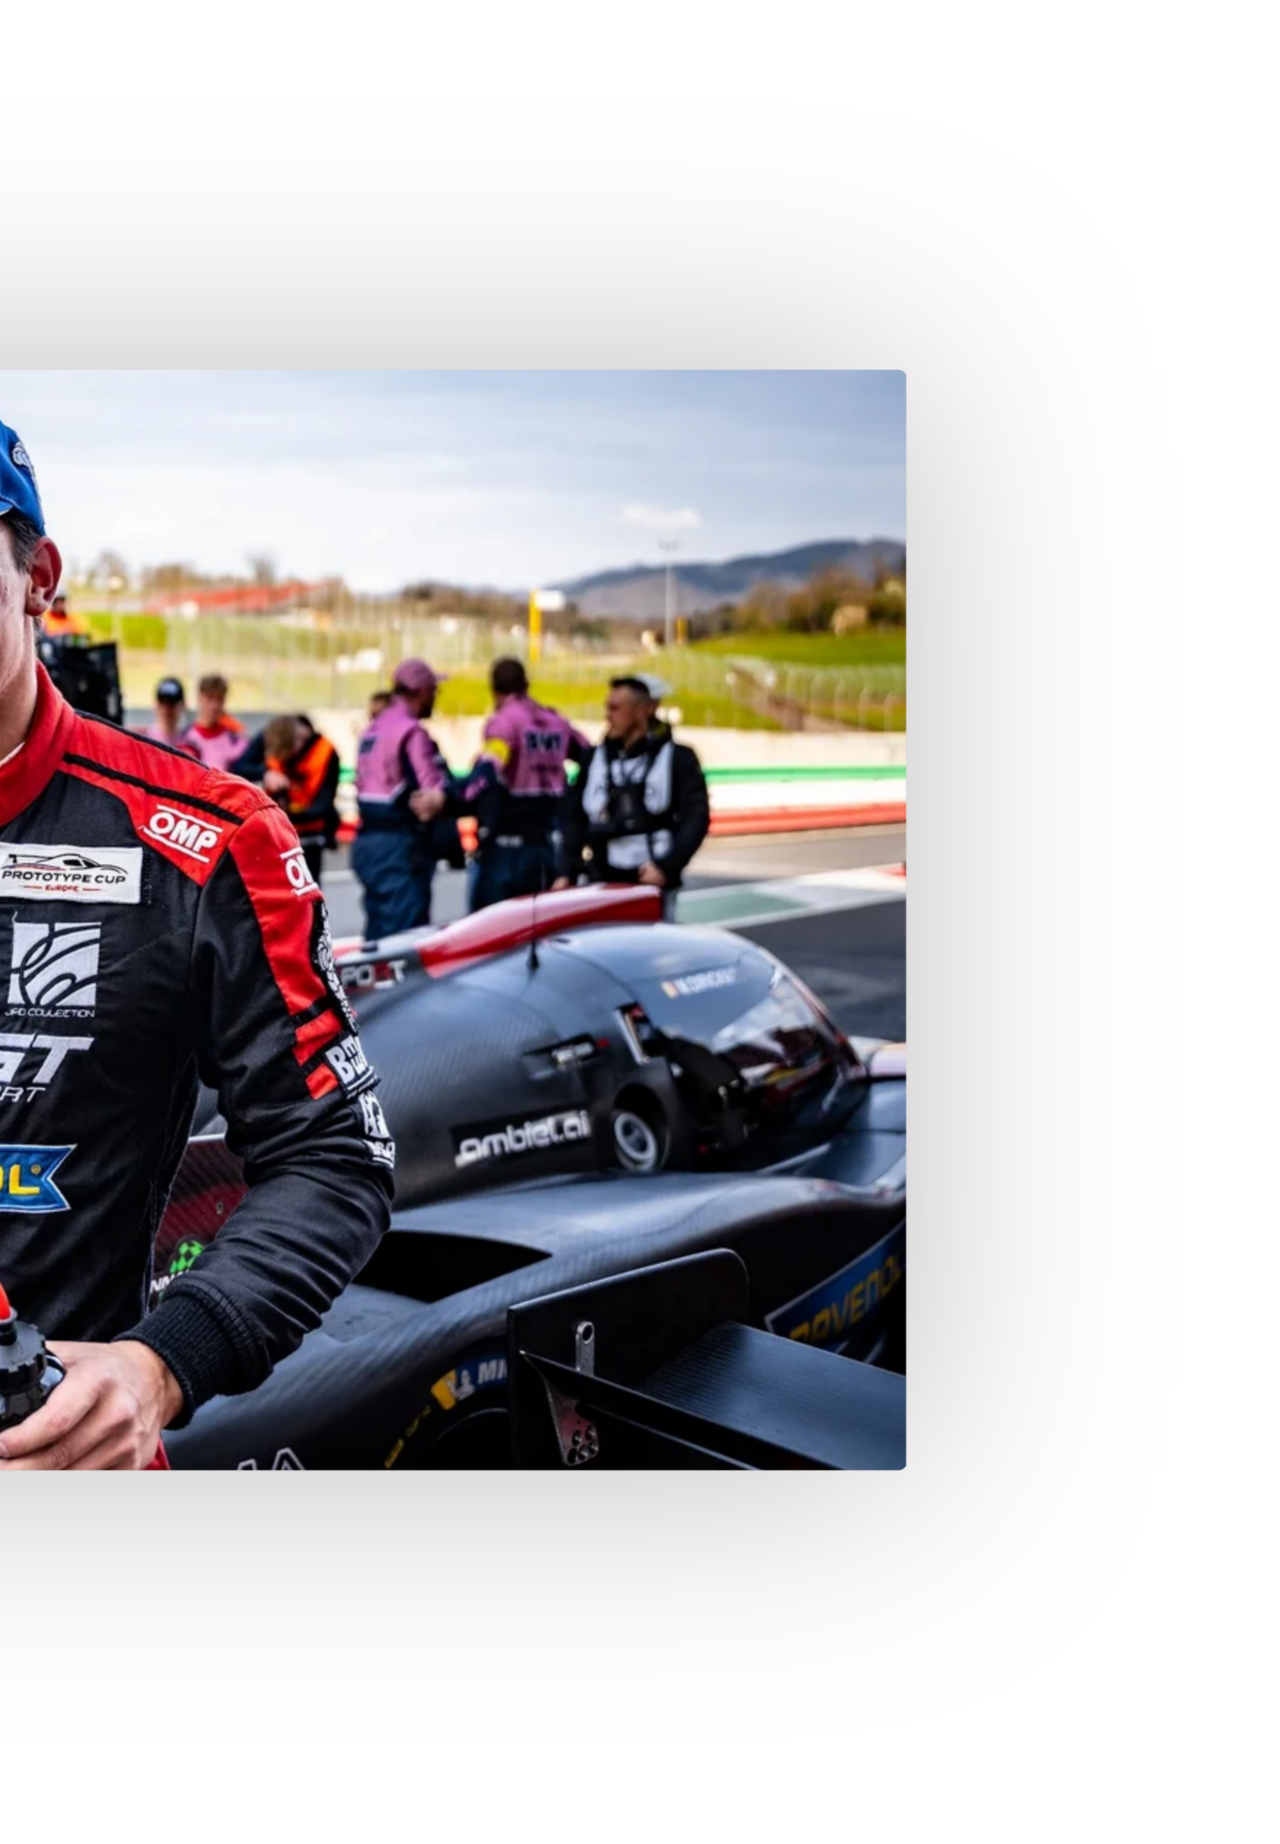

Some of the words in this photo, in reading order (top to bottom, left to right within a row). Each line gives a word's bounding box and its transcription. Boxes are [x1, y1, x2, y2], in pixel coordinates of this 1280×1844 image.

[150, 812, 217, 852] OMP
[2, 870, 91, 883] PROTOTYPE
[94, 875, 126, 884] CUP
